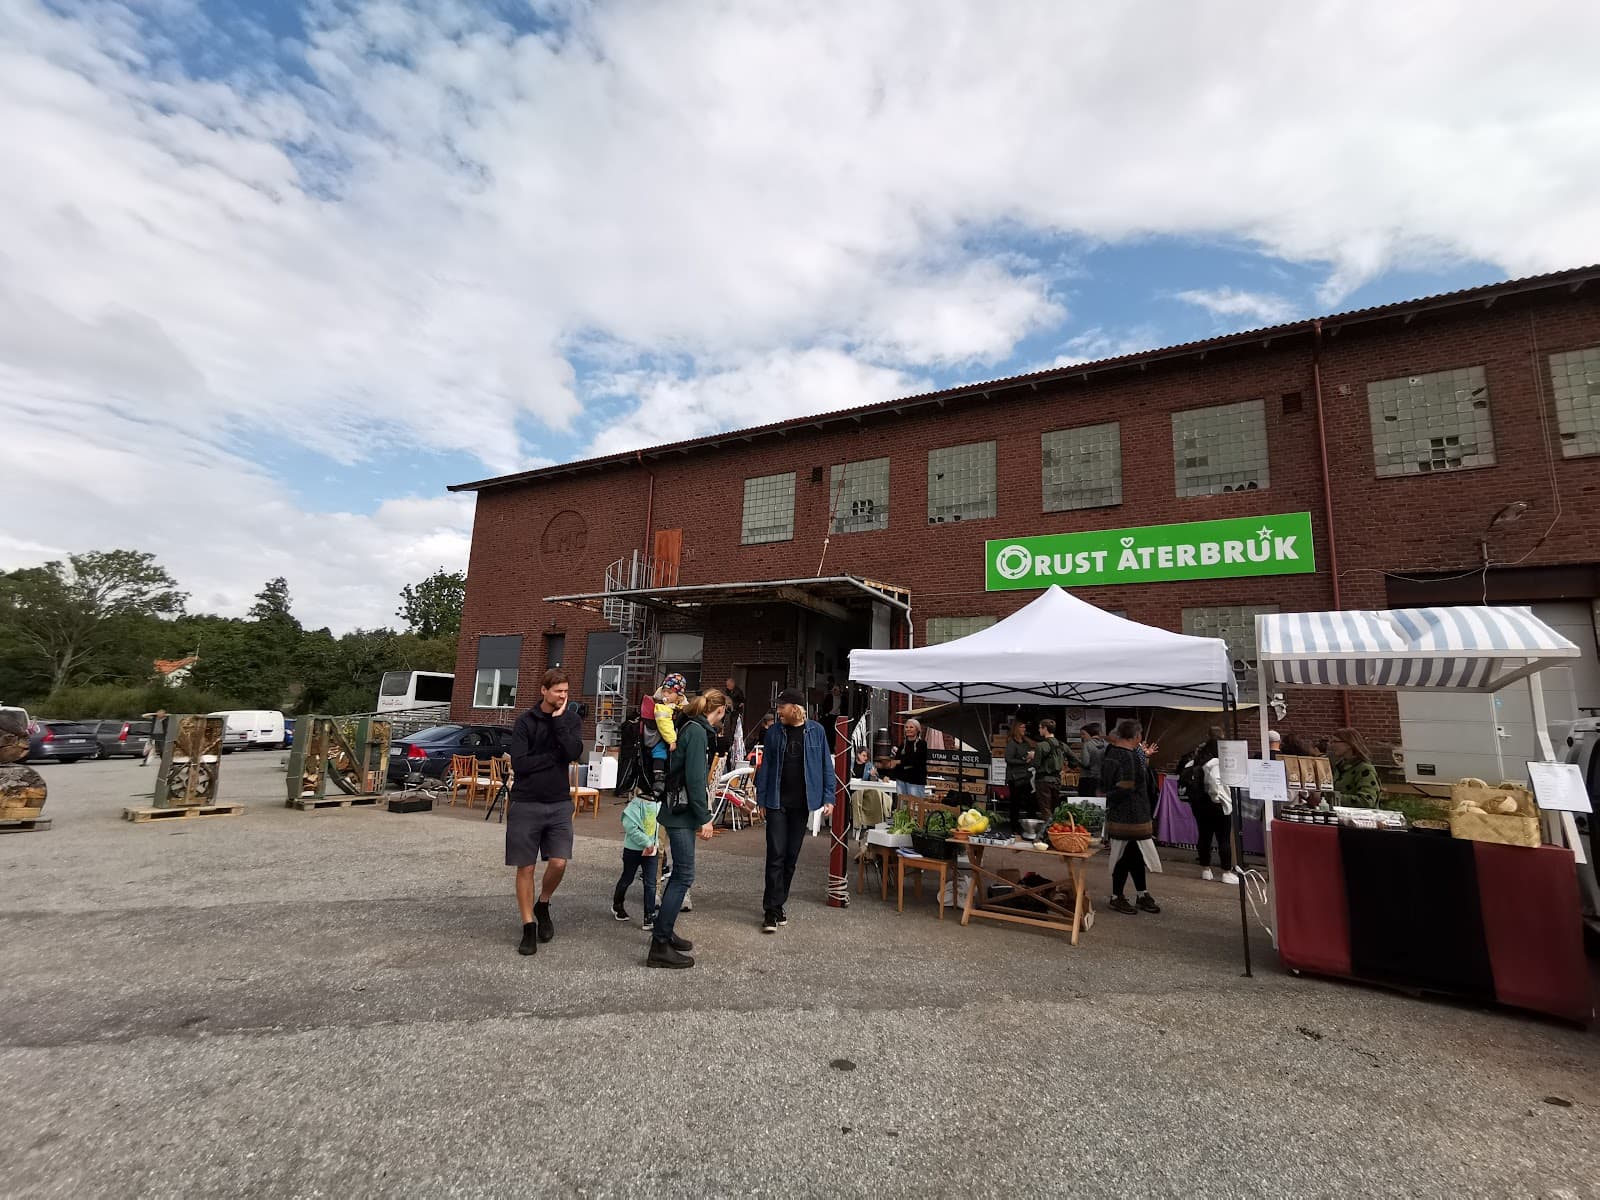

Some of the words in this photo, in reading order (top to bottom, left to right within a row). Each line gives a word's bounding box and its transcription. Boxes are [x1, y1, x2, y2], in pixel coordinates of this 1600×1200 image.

[995, 544, 1108, 580] ORUST
[1117, 531, 1299, 571] ÅTERBRUK
[951, 754, 980, 763] GRNSER
